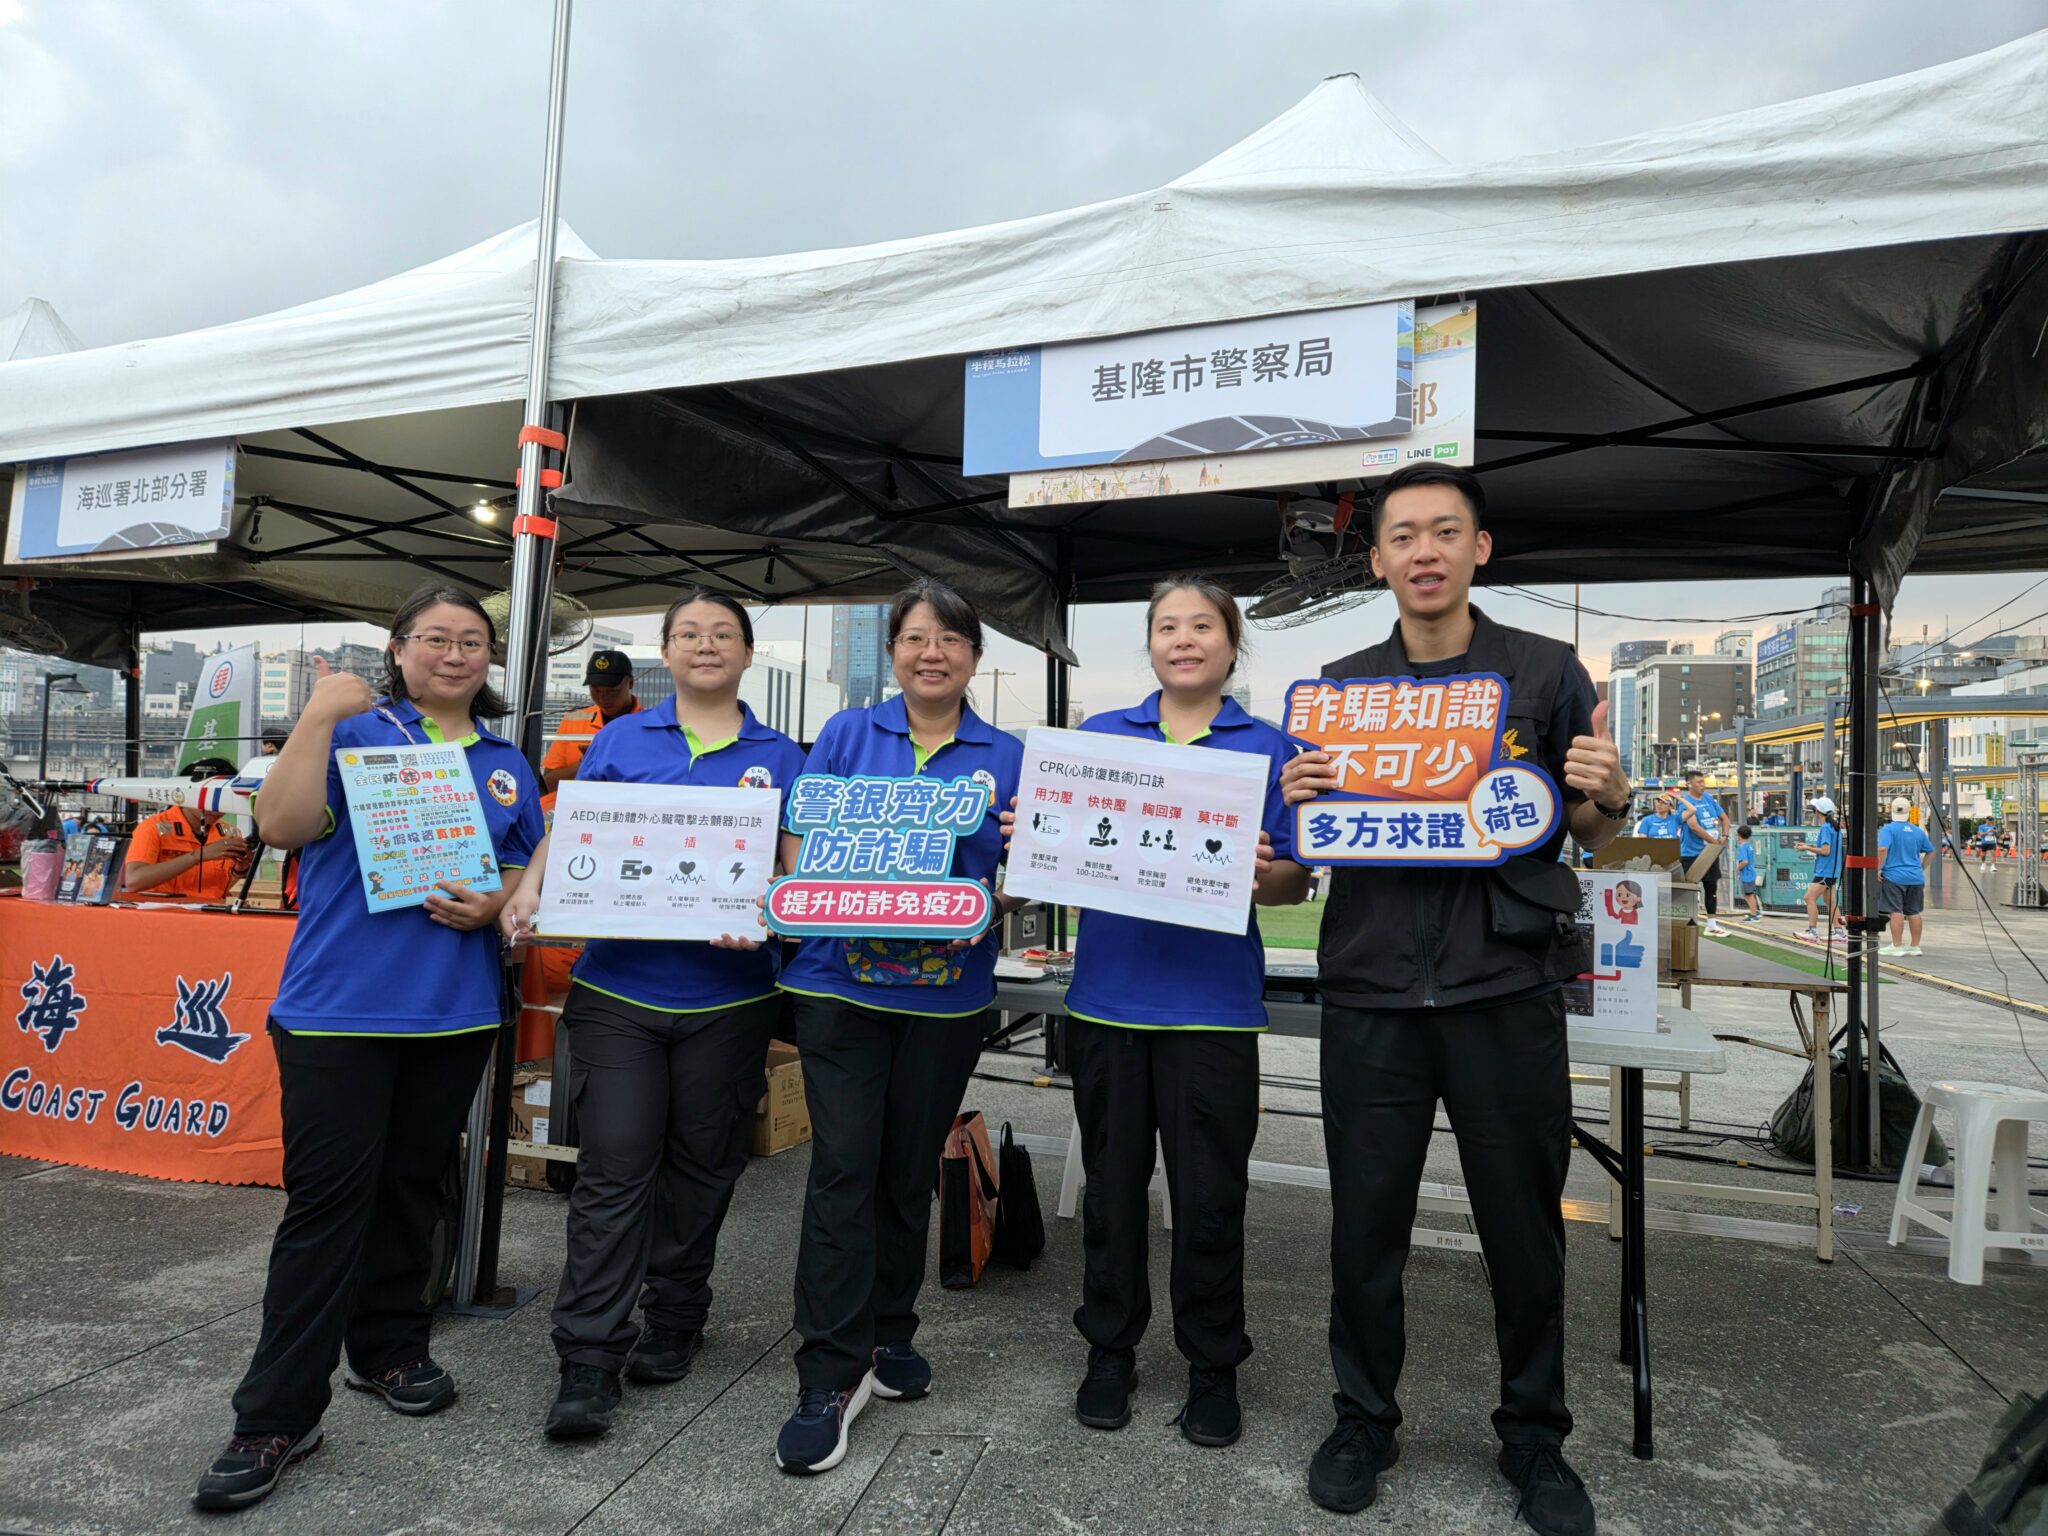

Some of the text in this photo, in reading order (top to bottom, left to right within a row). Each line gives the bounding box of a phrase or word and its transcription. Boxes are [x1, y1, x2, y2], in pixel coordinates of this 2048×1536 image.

[1091, 337, 1334, 403] 基隆市警察局
[1407, 448, 1432, 459] LINE
[1436, 446, 1456, 457] Pay
[77, 470, 208, 511] 海巡署北部分署
[1290, 679, 1500, 733] 詐騙知識
[1039, 760, 1165, 788] CPR(心肺復甦術)口訣
[1323, 739, 1474, 788] 不可少
[793, 779, 985, 825] 警銀齊力
[1490, 774, 1520, 802] 保
[569, 810, 763, 829] AED(自動體外心臟電擊去顫器)口訣
[1034, 787, 1239, 829] 用力壓 快快壓 胸回彈 莫中斷
[1482, 801, 1540, 834] 荷包
[580, 833, 746, 851] 開 貼 插 電
[1308, 811, 1466, 849] 多方求證
[800, 827, 951, 873] 防詐騙
[1030, 860, 1058, 872] 至少5cm
[1790, 872, 1808, 881] (03)
[1137, 877, 1166, 889] 完全回彈
[1187, 876, 1230, 890] 避免按壓中斷
[781, 890, 977, 916] 提升防詐免疫力
[1661, 904, 1688, 913] box3
[16, 954, 252, 1064] 海 巡
